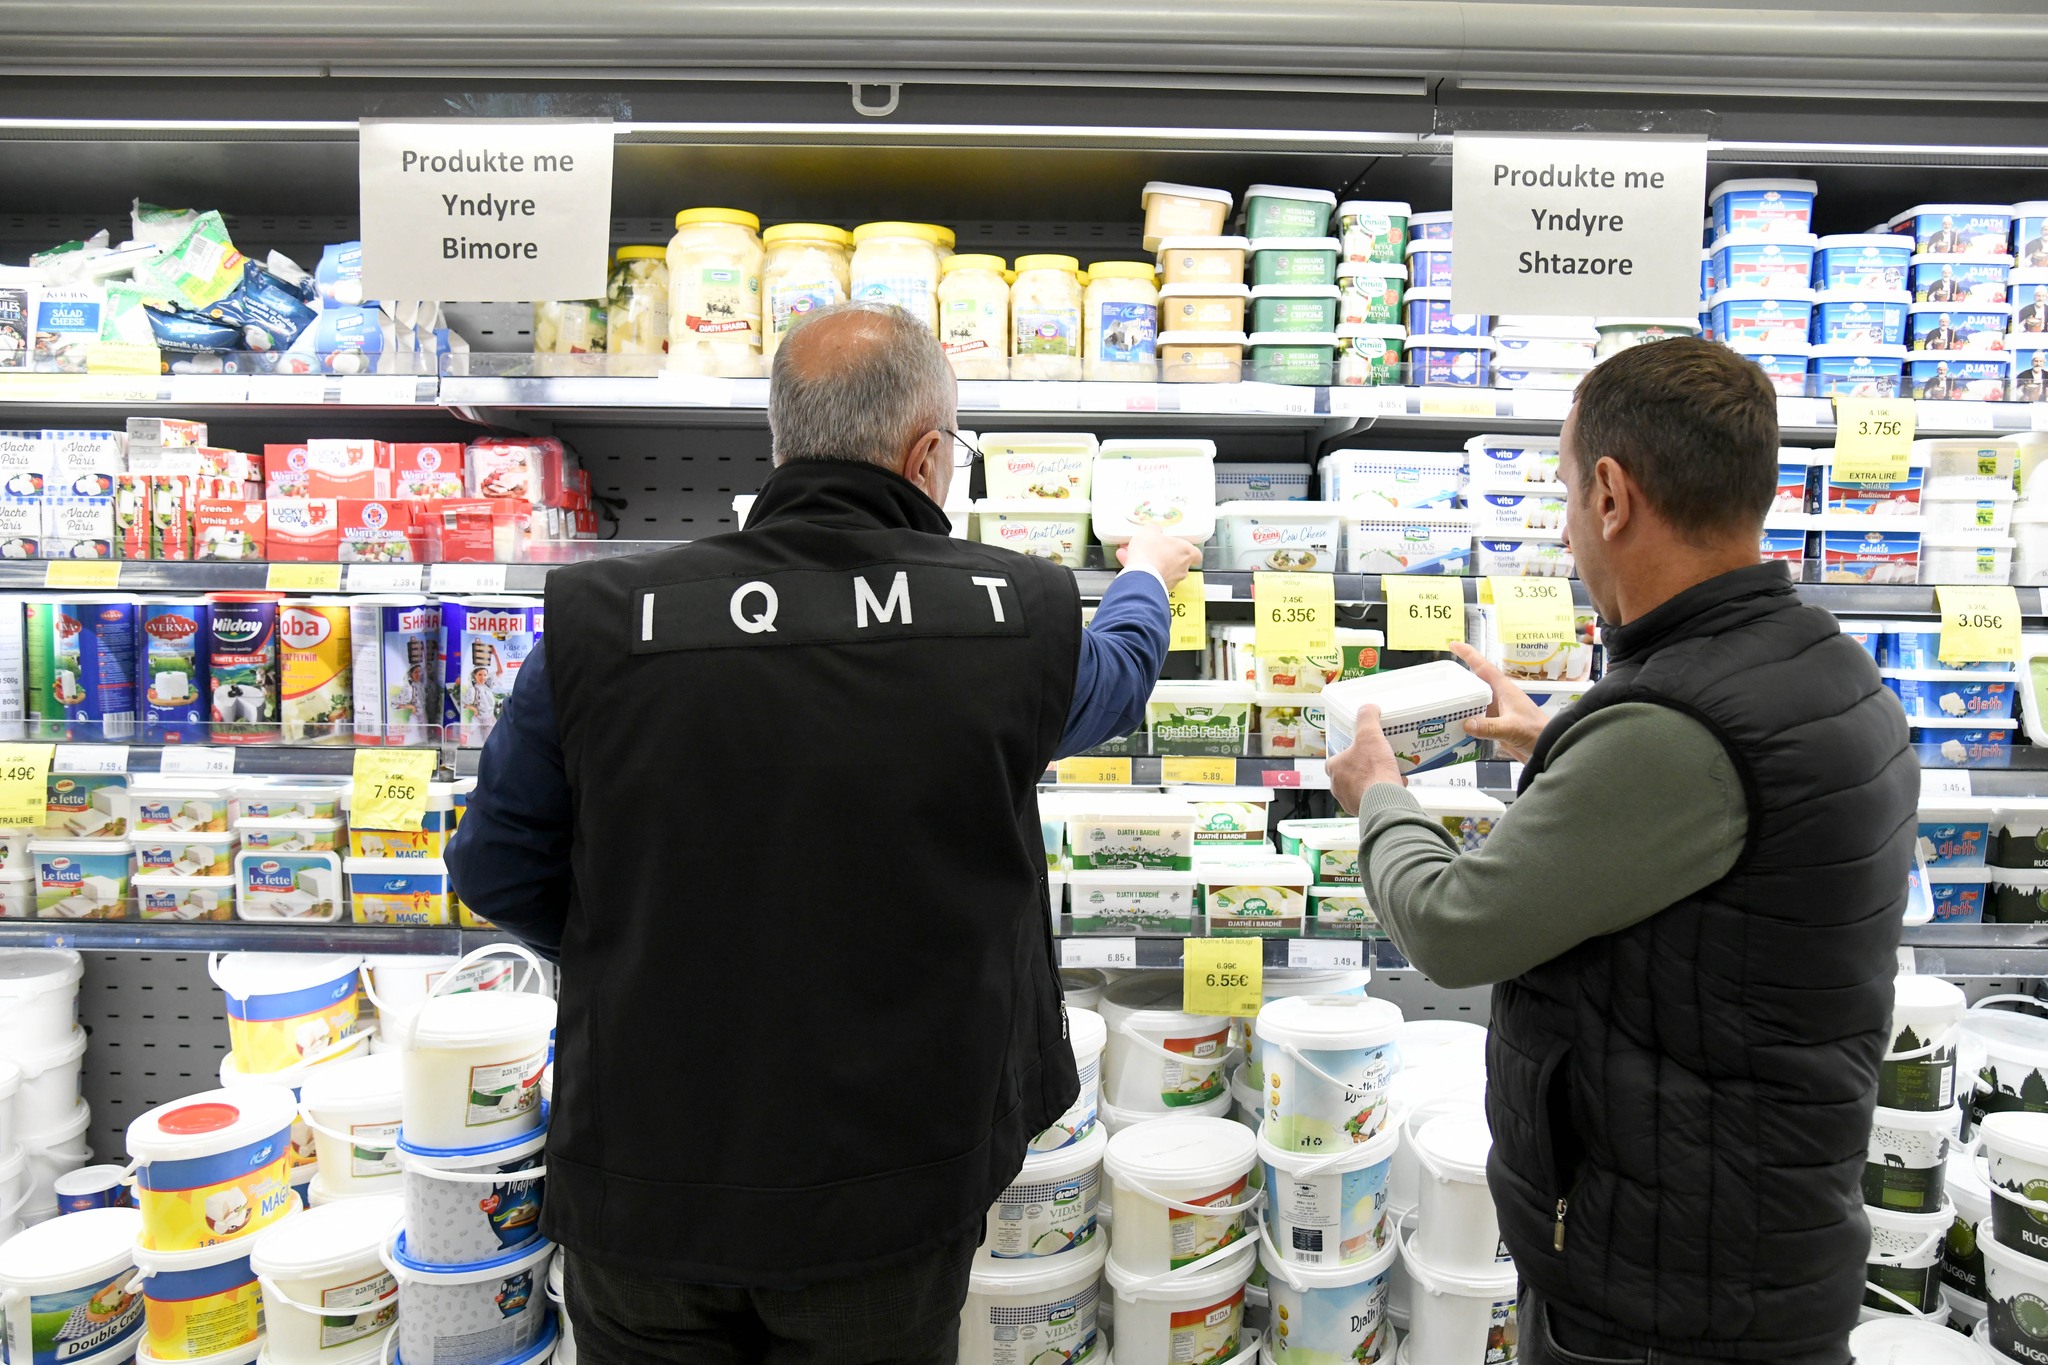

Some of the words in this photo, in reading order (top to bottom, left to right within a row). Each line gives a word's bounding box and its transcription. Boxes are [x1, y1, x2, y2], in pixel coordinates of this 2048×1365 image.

[402, 149, 524, 172] Produkte
[534, 154, 574, 172] me
[1494, 164, 1615, 188] Produkte
[1624, 171, 1665, 188] me
[442, 193, 535, 222] Yndyre
[1531, 208, 1624, 237] Yndyre
[1970, 217, 2002, 227] DJATH
[443, 237, 537, 259] Bimore
[1518, 251, 1633, 275] Shtazore
[1969, 267, 2002, 277] DJATH
[52, 309, 83, 318] SALAD
[50, 317, 85, 326] CHEESE
[1967, 315, 2000, 325] DJATH
[1965, 364, 1999, 374] DJATH
[1858, 421, 1901, 436] 3.75€
[1, 441, 35, 452] Vache
[67, 441, 101, 453] Vache
[1496, 450, 1514, 459] vita
[1, 455, 29, 467] Paris
[67, 455, 96, 467] Paris
[1498, 468, 1522, 476] bardhë
[1849, 472, 1874, 480] EXTRA
[1860, 482, 1890, 490] Salakis
[1857, 491, 1891, 499] Traditional
[1497, 496, 1514, 505] vita
[67, 507, 100, 518] Vache
[200, 504, 233, 514] French
[1500, 514, 1523, 523] bardhë
[66, 521, 94, 532] Paris
[1280, 529, 1299, 544] Cow
[1300, 527, 1328, 541] Cheese
[1398, 542, 1435, 551] VIDAS
[1494, 543, 1511, 552] vita
[1859, 543, 1888, 553] Salakis
[1856, 554, 1890, 562] Traditional
[307, 576, 325, 585] 2.85
[392, 578, 410, 587] 2.39
[476, 578, 493, 587] 6.89
[1514, 586, 1558, 598] 3.39€
[1272, 608, 1316, 623] 6.35€
[1409, 605, 1452, 619] 6.15€
[212, 618, 262, 634] Milday
[470, 617, 522, 631] SHARRI
[1958, 613, 2003, 629] 3.05€
[151, 623, 191, 632] VERNA
[1968, 696, 2003, 714] djath
[1157, 726, 1198, 740] Djathë
[1420, 723, 1444, 734] drena
[1411, 733, 1450, 749] VIDAS
[1969, 743, 2003, 760] djath
[99, 762, 116, 771] 7.59
[206, 762, 223, 770] 7.49
[1098, 773, 1116, 781] 3.09
[1202, 772, 1221, 780] 5.89
[1449, 779, 1466, 787] 4.39
[1942, 784, 1960, 792] 3.45
[374, 785, 415, 800] 7.65€
[59, 794, 84, 804] fette
[150, 810, 170, 819] fette
[1210, 822, 1233, 831] MALI
[1117, 828, 1136, 836] DJATH
[1139, 828, 1161, 836] BARDHË
[1197, 832, 1219, 840] DJATHË
[1223, 832, 1247, 840] BARDHË
[396, 850, 428, 858] MAGIC
[1939, 841, 1976, 859] djath
[152, 855, 173, 863] fette
[42, 871, 55, 881] Le
[57, 870, 81, 881] fette
[250, 875, 263, 885] Le
[264, 874, 291, 885] fette
[1116, 890, 1136, 899] DJATH
[1139, 890, 1160, 898] BARDHË
[1937, 902, 1974, 919] djath
[396, 913, 428, 923] MAGIC
[1228, 919, 1250, 927] DJATHË
[1254, 919, 1282, 927] BARDHË
[1107, 953, 1125, 963] 6.85
[1334, 957, 1351, 966] 3.49
[1206, 974, 1249, 987] 6.55€
[1055, 1187, 1079, 1200] drena
[1050, 1202, 1082, 1219] VIDAS
[1050, 1307, 1075, 1320] drena
[1209, 1310, 1228, 1324] BUDA
[1351, 1307, 1375, 1332] Djath
[1045, 1320, 1078, 1339] VIDAS
[69, 1325, 117, 1354] Double
